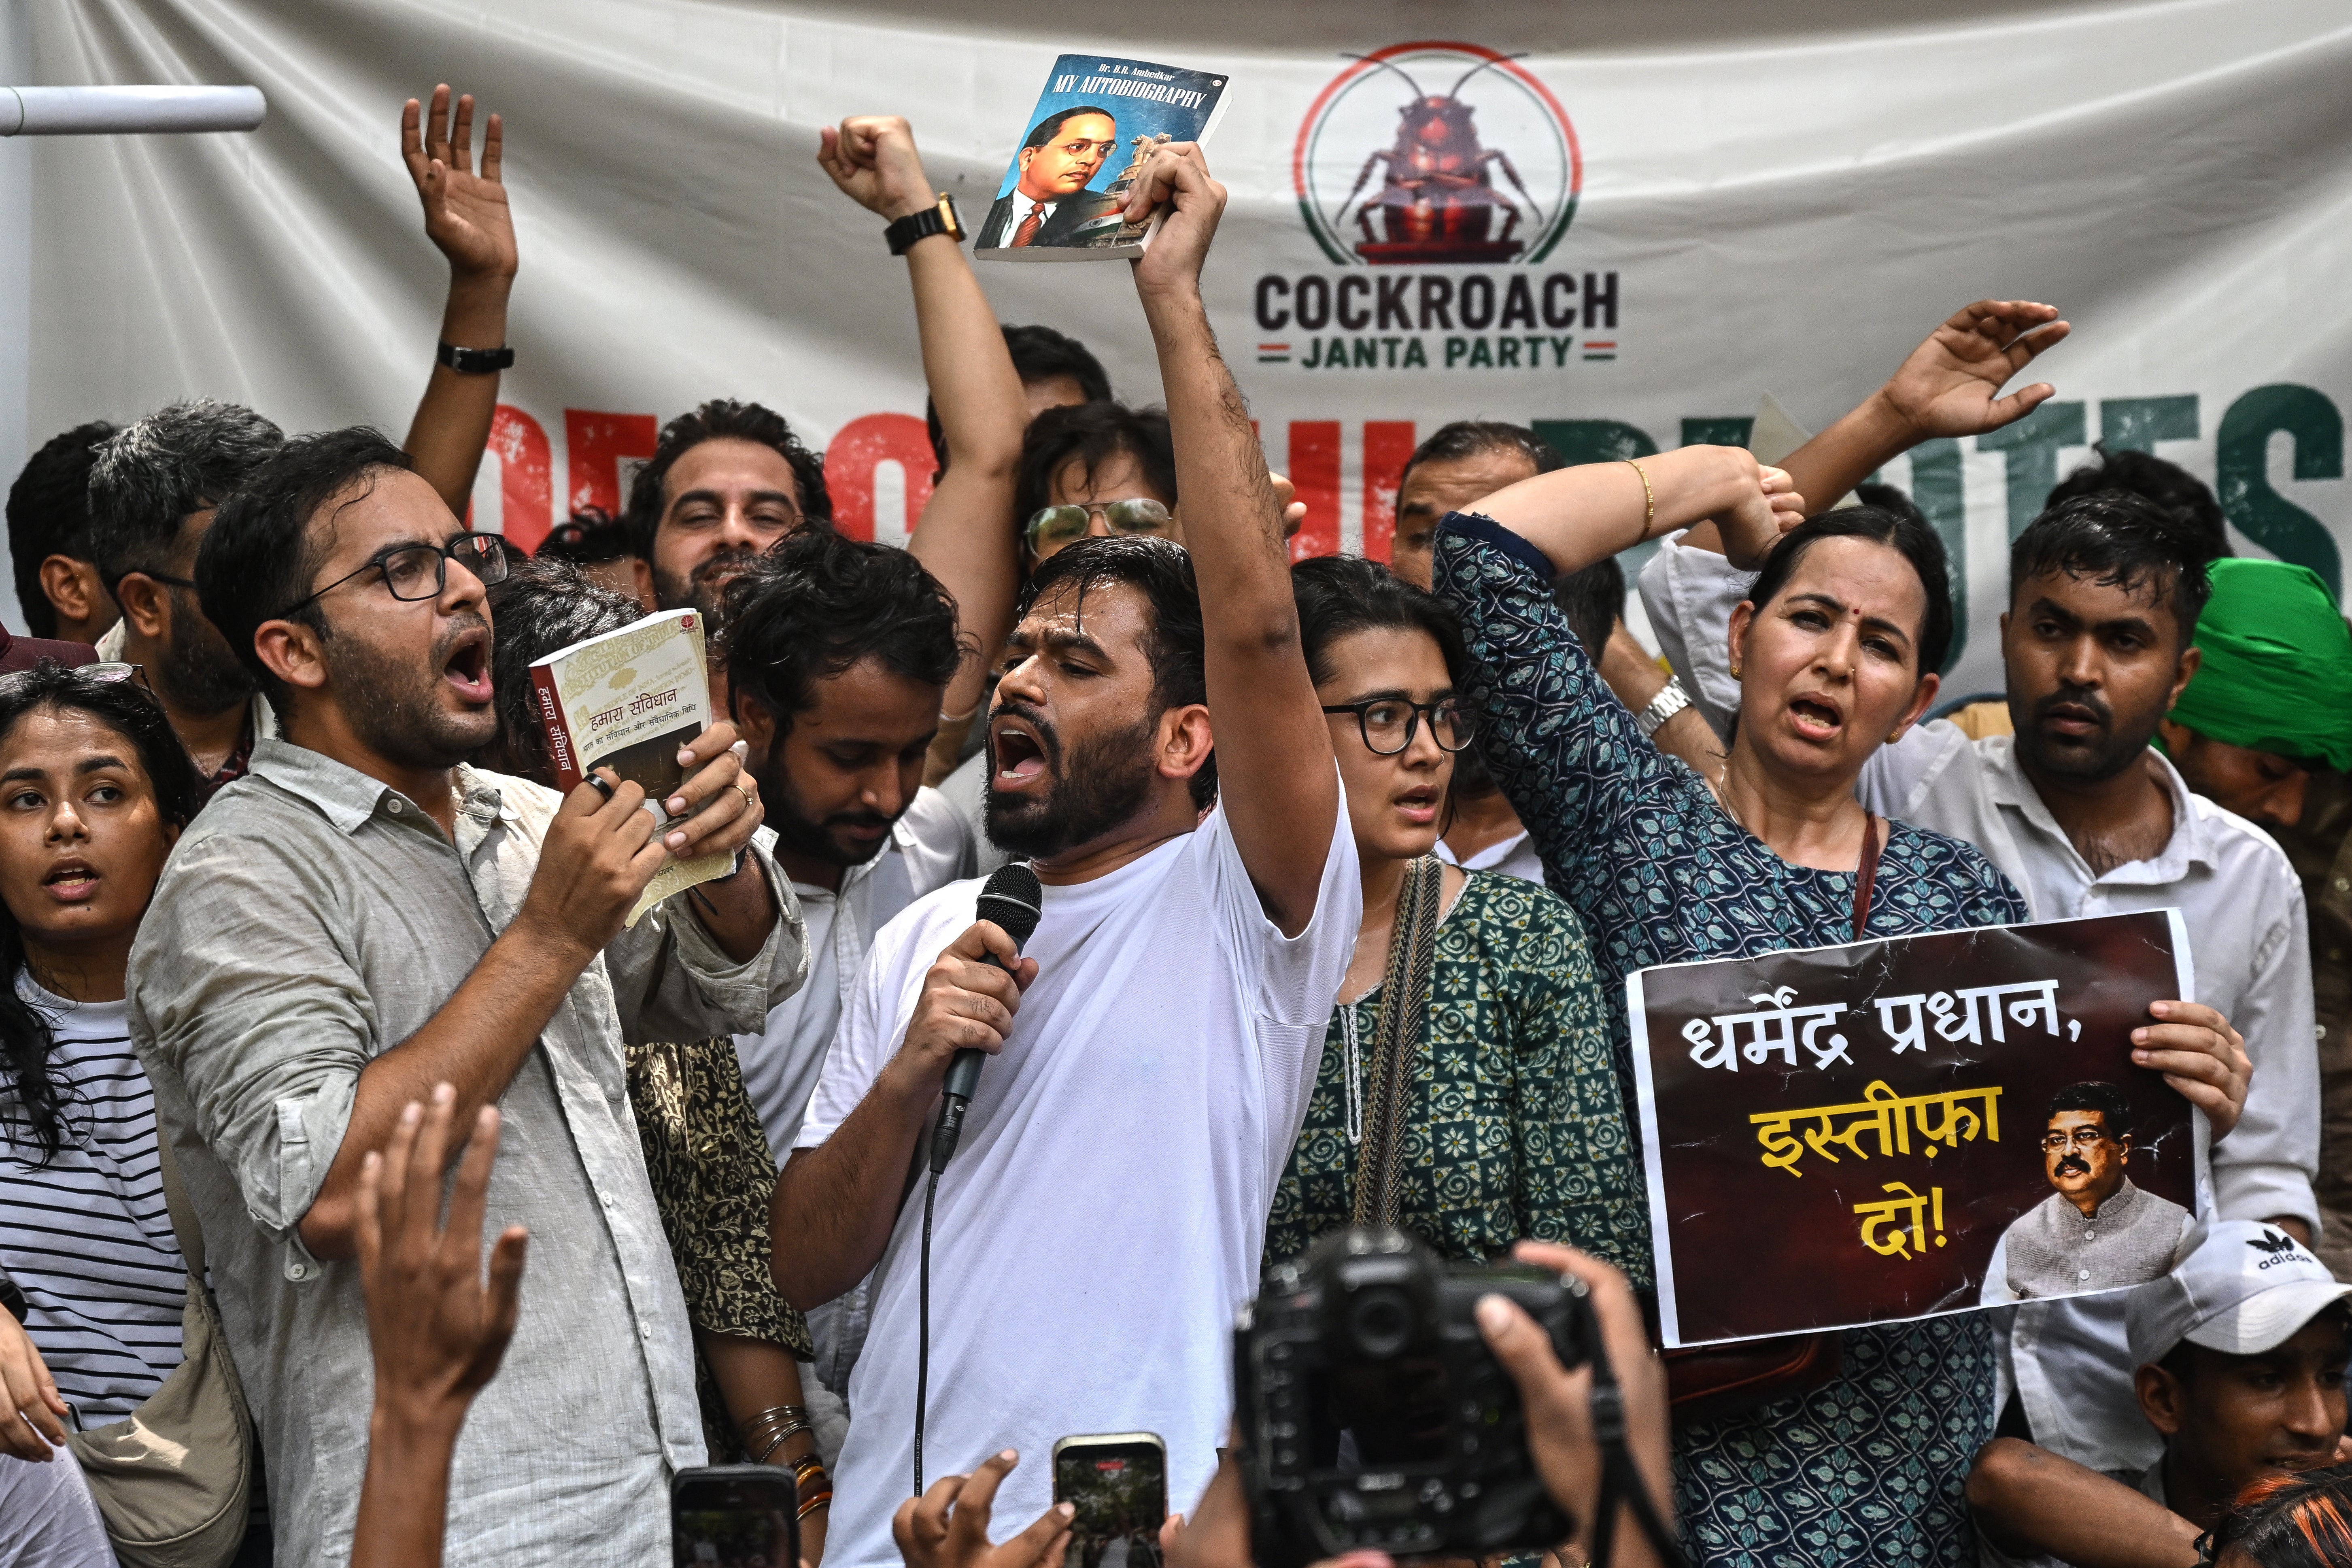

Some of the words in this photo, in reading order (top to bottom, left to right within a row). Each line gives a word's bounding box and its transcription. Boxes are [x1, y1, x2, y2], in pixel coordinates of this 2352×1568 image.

[1052, 74, 1080, 93] MY
[1077, 76, 1207, 109] AUTOBIOGRAPHY
[1098, 63, 1111, 72] Dr.
[1113, 66, 1129, 75] B.R.
[1131, 67, 1175, 82] Ambedkar
[1255, 272, 1619, 331] COCKROACH
[1301, 337, 1428, 369] JANTA
[1445, 336, 1573, 368] PARTY
[538, 686, 557, 720] हमारा
[550, 725, 572, 771] संविधान
[589, 706, 623, 731] हमारा
[629, 688, 677, 716] संविधान
[596, 737, 603, 745] का
[606, 727, 630, 741] संविधान
[634, 721, 646, 731] और
[682, 703, 697, 715] विधि
[1875, 979, 2082, 1056] प्रधान,
[1749, 1080, 2003, 1179] इस्तीफ़ा
[1853, 1180, 1947, 1262] दो!
[2259, 1253, 2313, 1270] adidas
